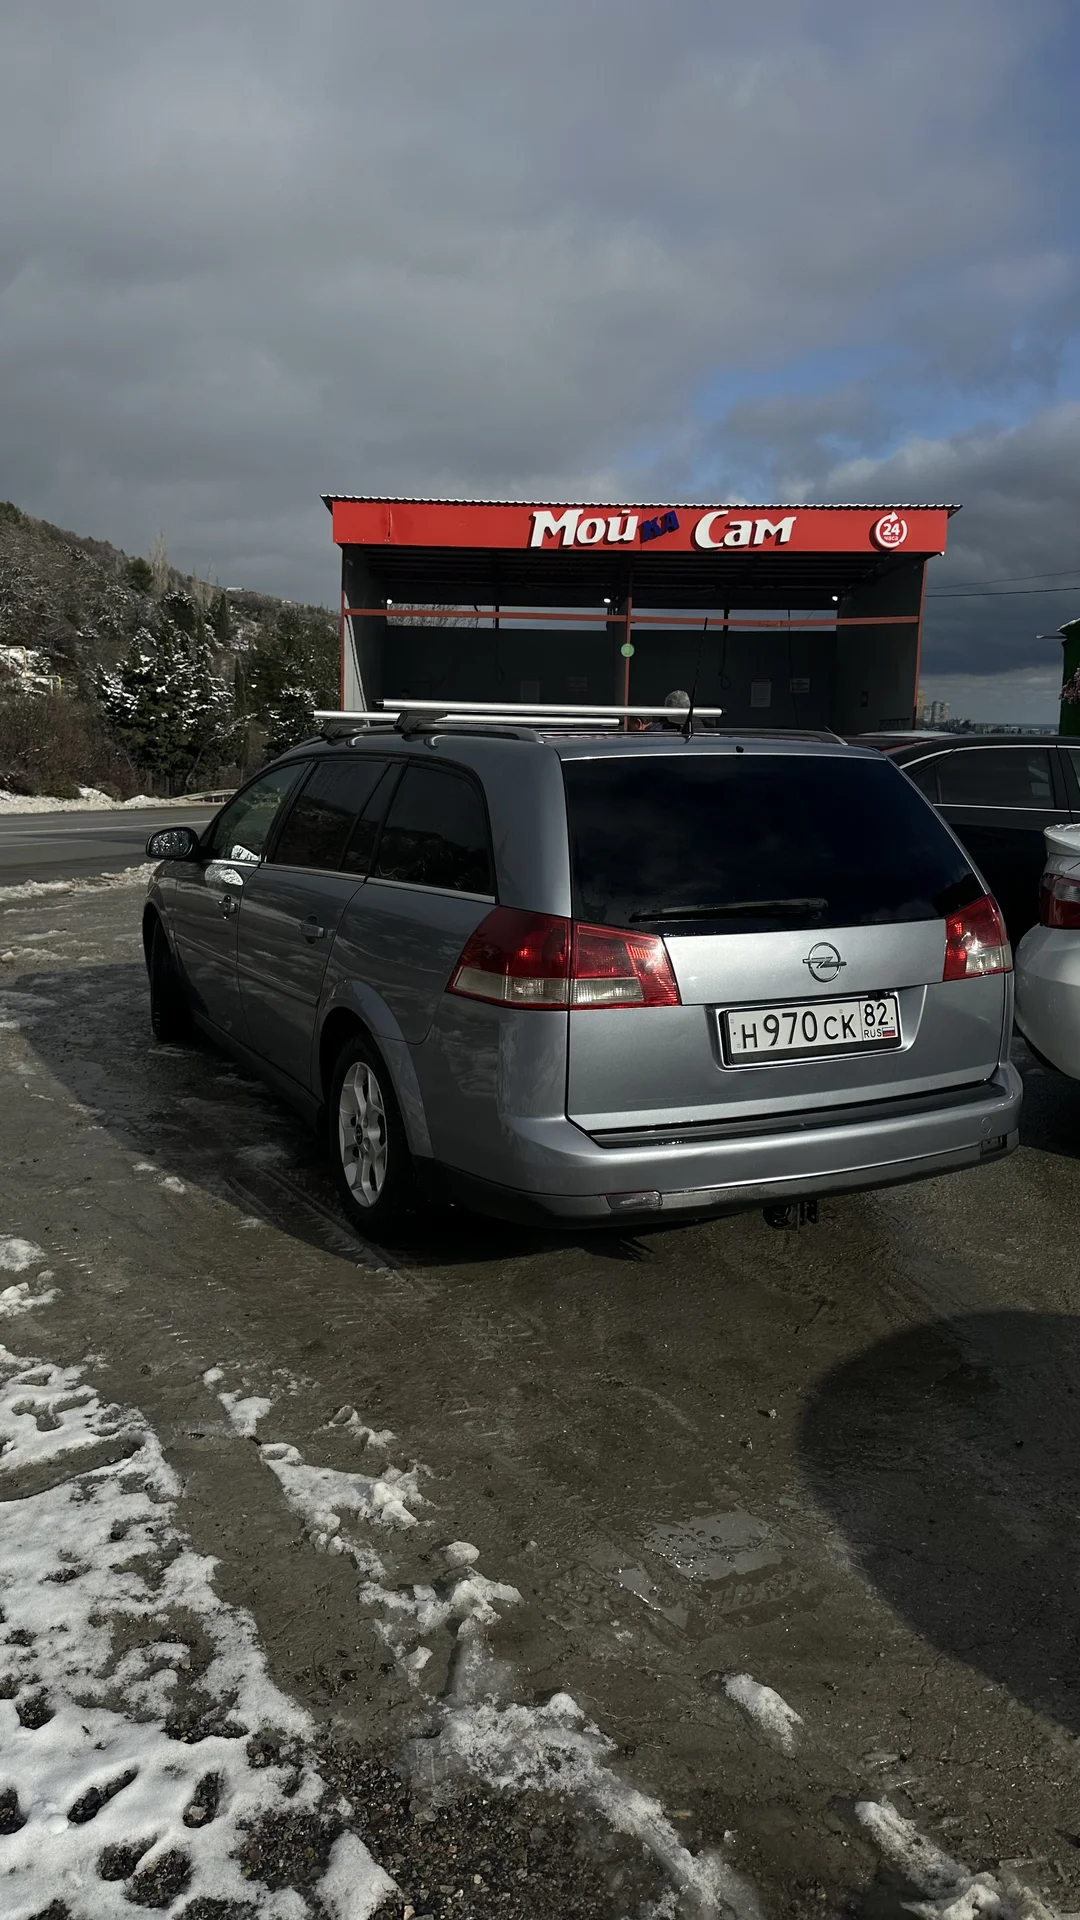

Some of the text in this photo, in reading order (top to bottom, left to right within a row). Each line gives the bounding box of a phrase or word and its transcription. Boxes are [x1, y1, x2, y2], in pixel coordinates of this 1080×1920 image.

[530, 509, 639, 548] Мой
[694, 510, 797, 549] Сам
[882, 523, 900, 536] 24
[864, 1002, 889, 1027] 82
[864, 1028, 882, 1039] RUS
